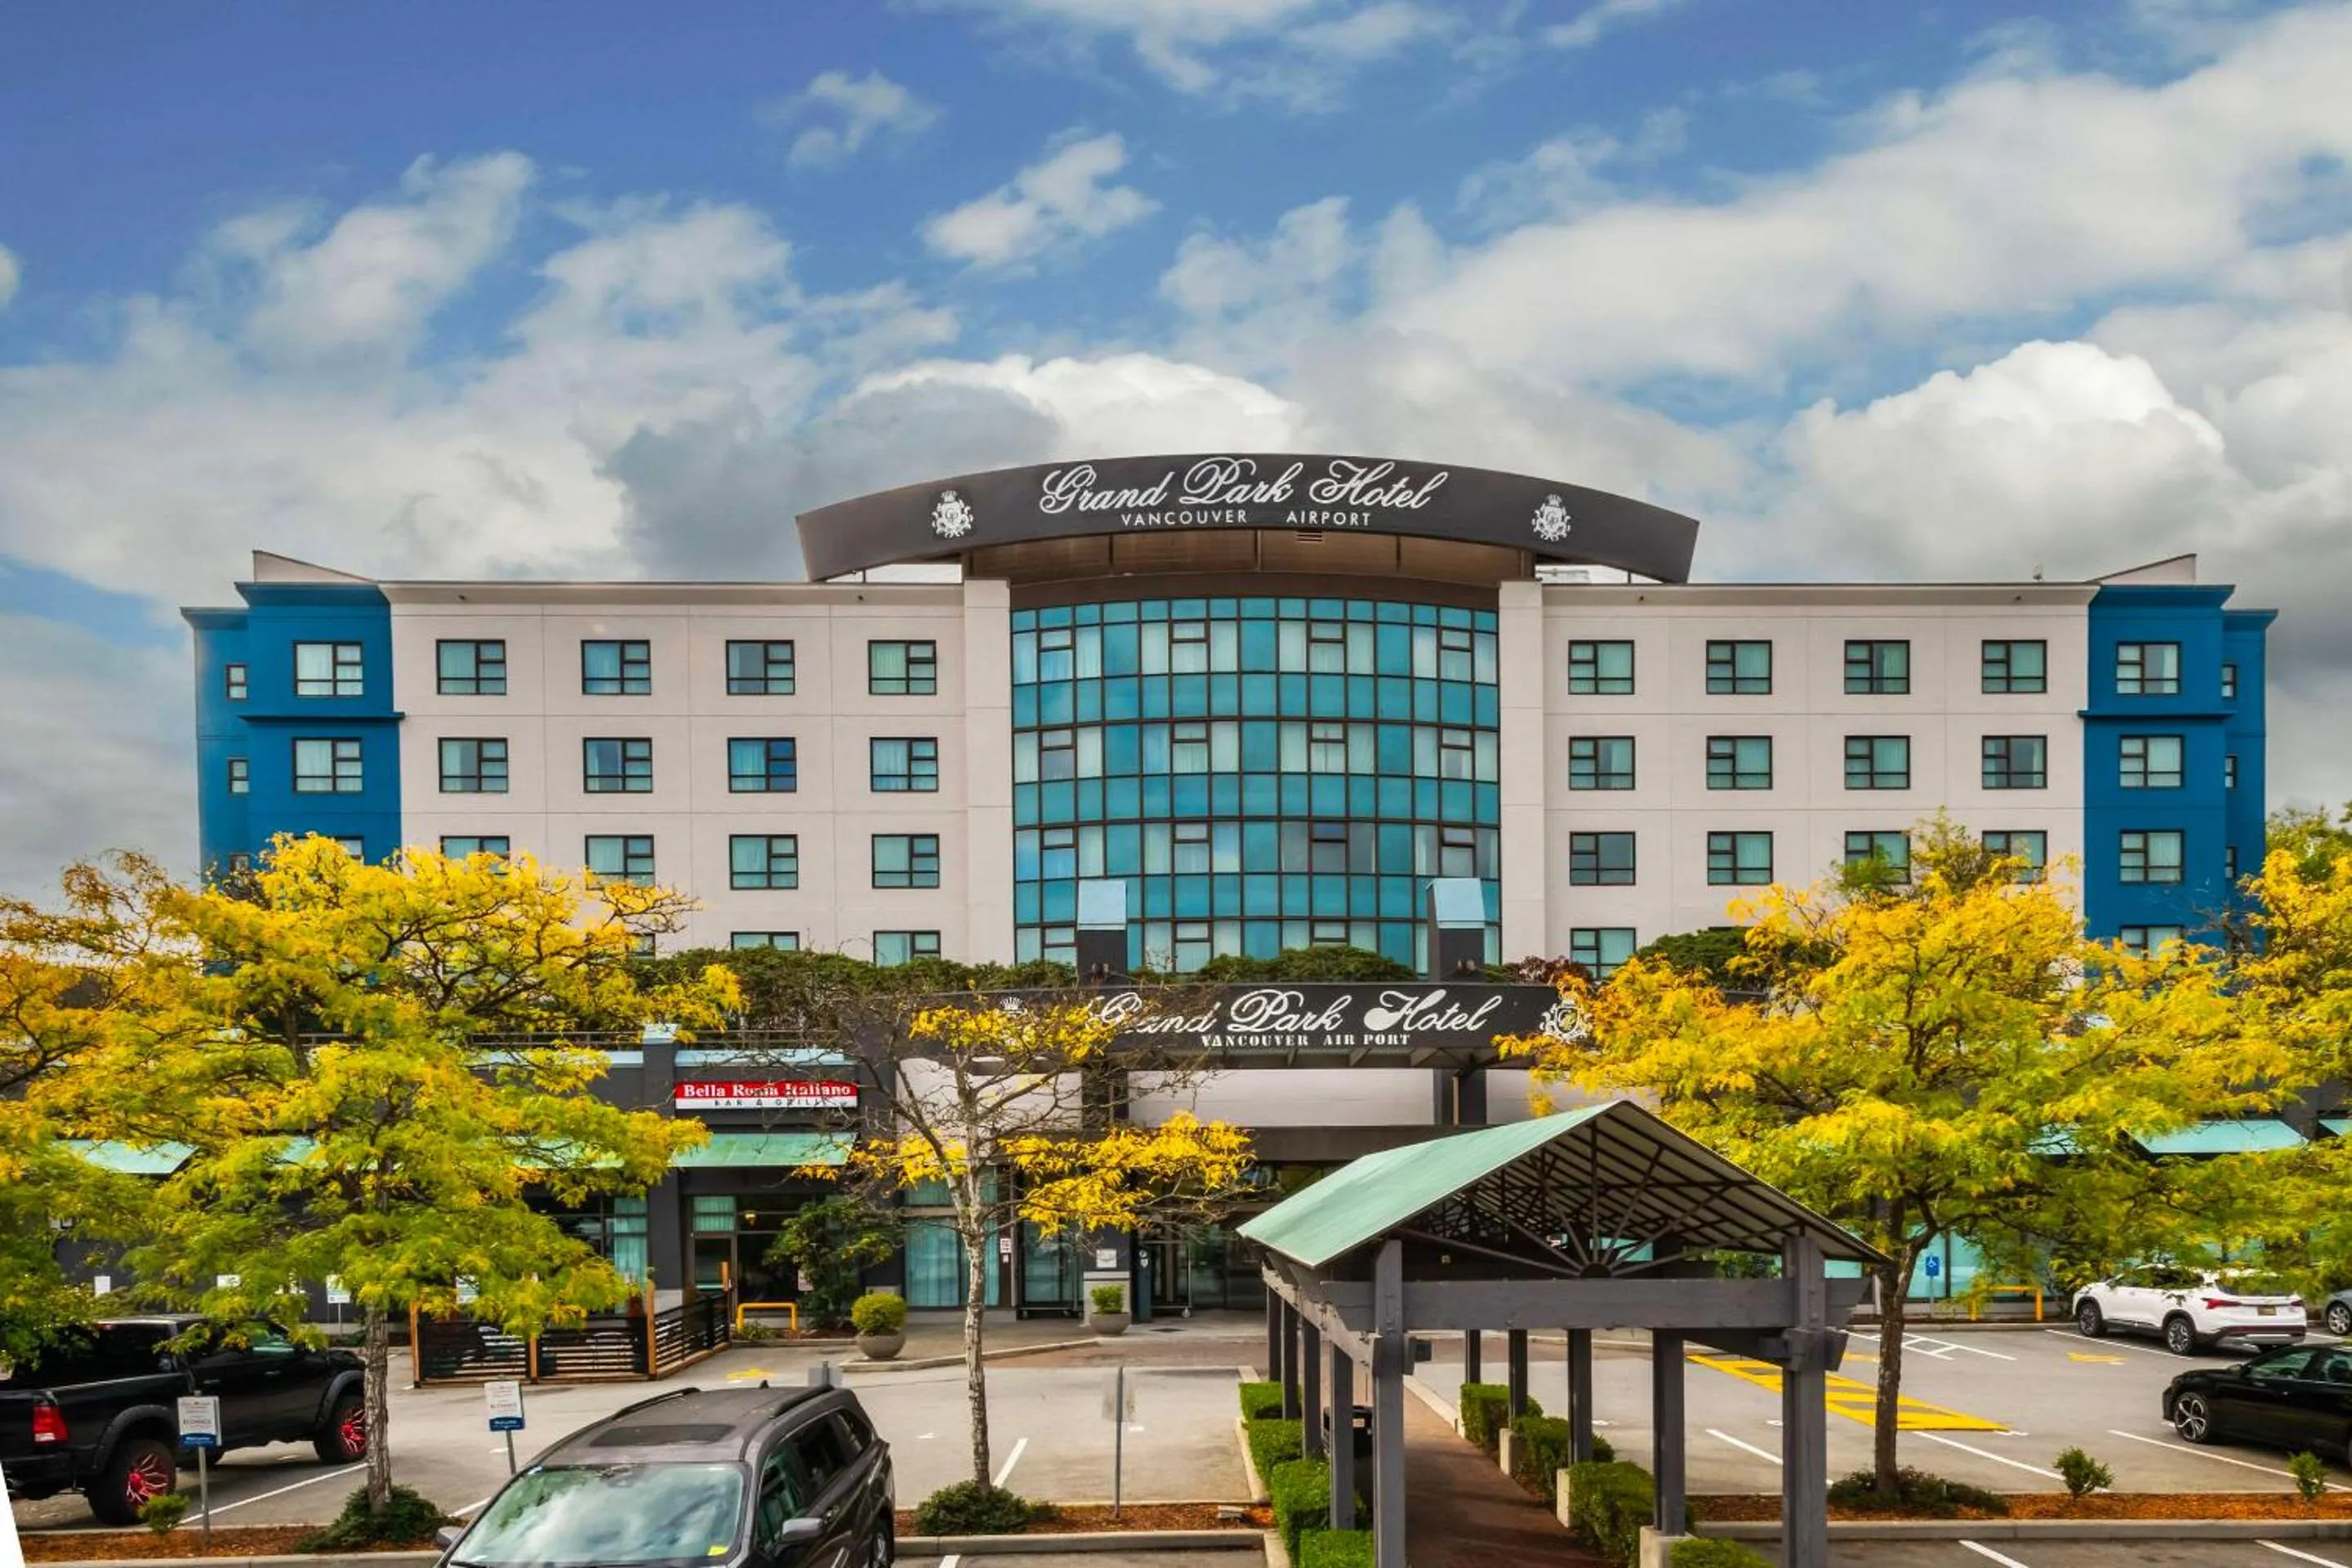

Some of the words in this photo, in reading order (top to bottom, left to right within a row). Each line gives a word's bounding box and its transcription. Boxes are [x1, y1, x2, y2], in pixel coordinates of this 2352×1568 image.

[1039, 464, 1176, 514] Grand
[1178, 457, 1304, 505] Park
[1308, 459, 1449, 510] Hotel
[1120, 509, 1248, 527] VANCOUVER
[1286, 510, 1372, 526] AIRPORT
[1227, 988, 1352, 1032] Park
[1363, 989, 1503, 1031] Hotel
[1200, 1034, 1309, 1047] VANCOUVER
[683, 1084, 726, 1097] Bella
[784, 1082, 851, 1096] Italiano
